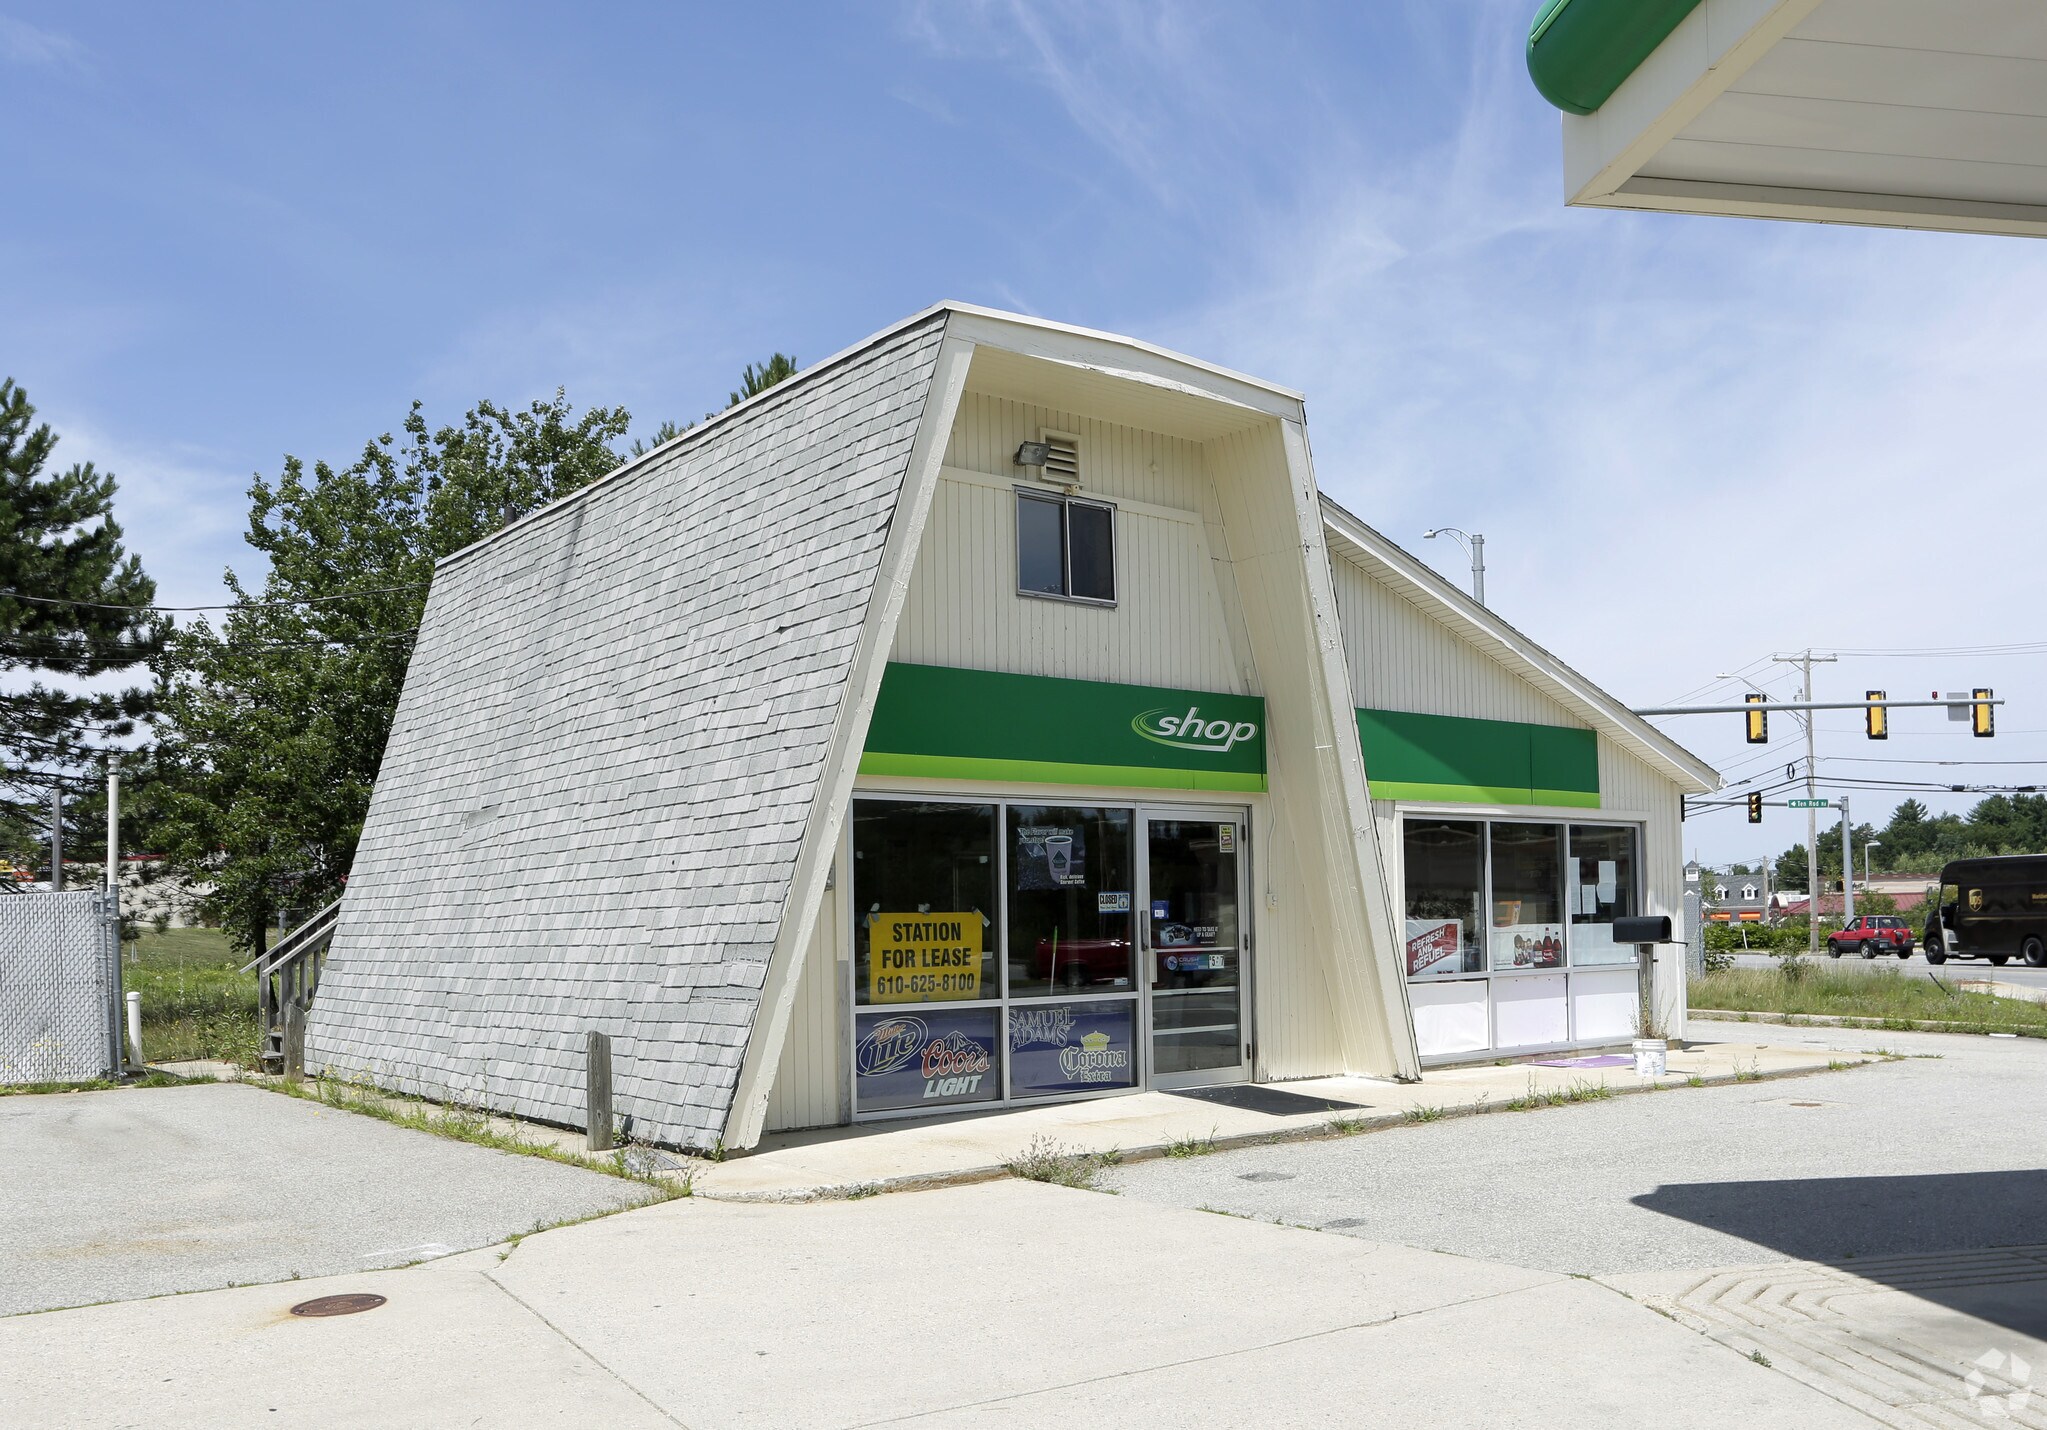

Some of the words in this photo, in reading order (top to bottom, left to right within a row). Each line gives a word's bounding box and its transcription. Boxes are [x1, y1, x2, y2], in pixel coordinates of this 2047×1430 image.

[1158, 706, 1258, 752] shop
[1099, 894, 1118, 905] CLOSED
[892, 922, 961, 942] STATION
[1411, 927, 1445, 952] REFRESH
[882, 948, 916, 969] FOR
[922, 947, 972, 967] LEASE
[1412, 946, 1446, 971] REFUEL
[1417, 943, 1433, 959] AND
[877, 972, 975, 995] 610-625-8100
[1009, 1006, 1076, 1032] SAMUEL
[863, 1032, 916, 1075] Lite
[921, 1038, 990, 1079] Coors
[1059, 1046, 1127, 1080] Corona
[922, 1075, 982, 1099] LIGHT
[1080, 1067, 1112, 1083] Extra
